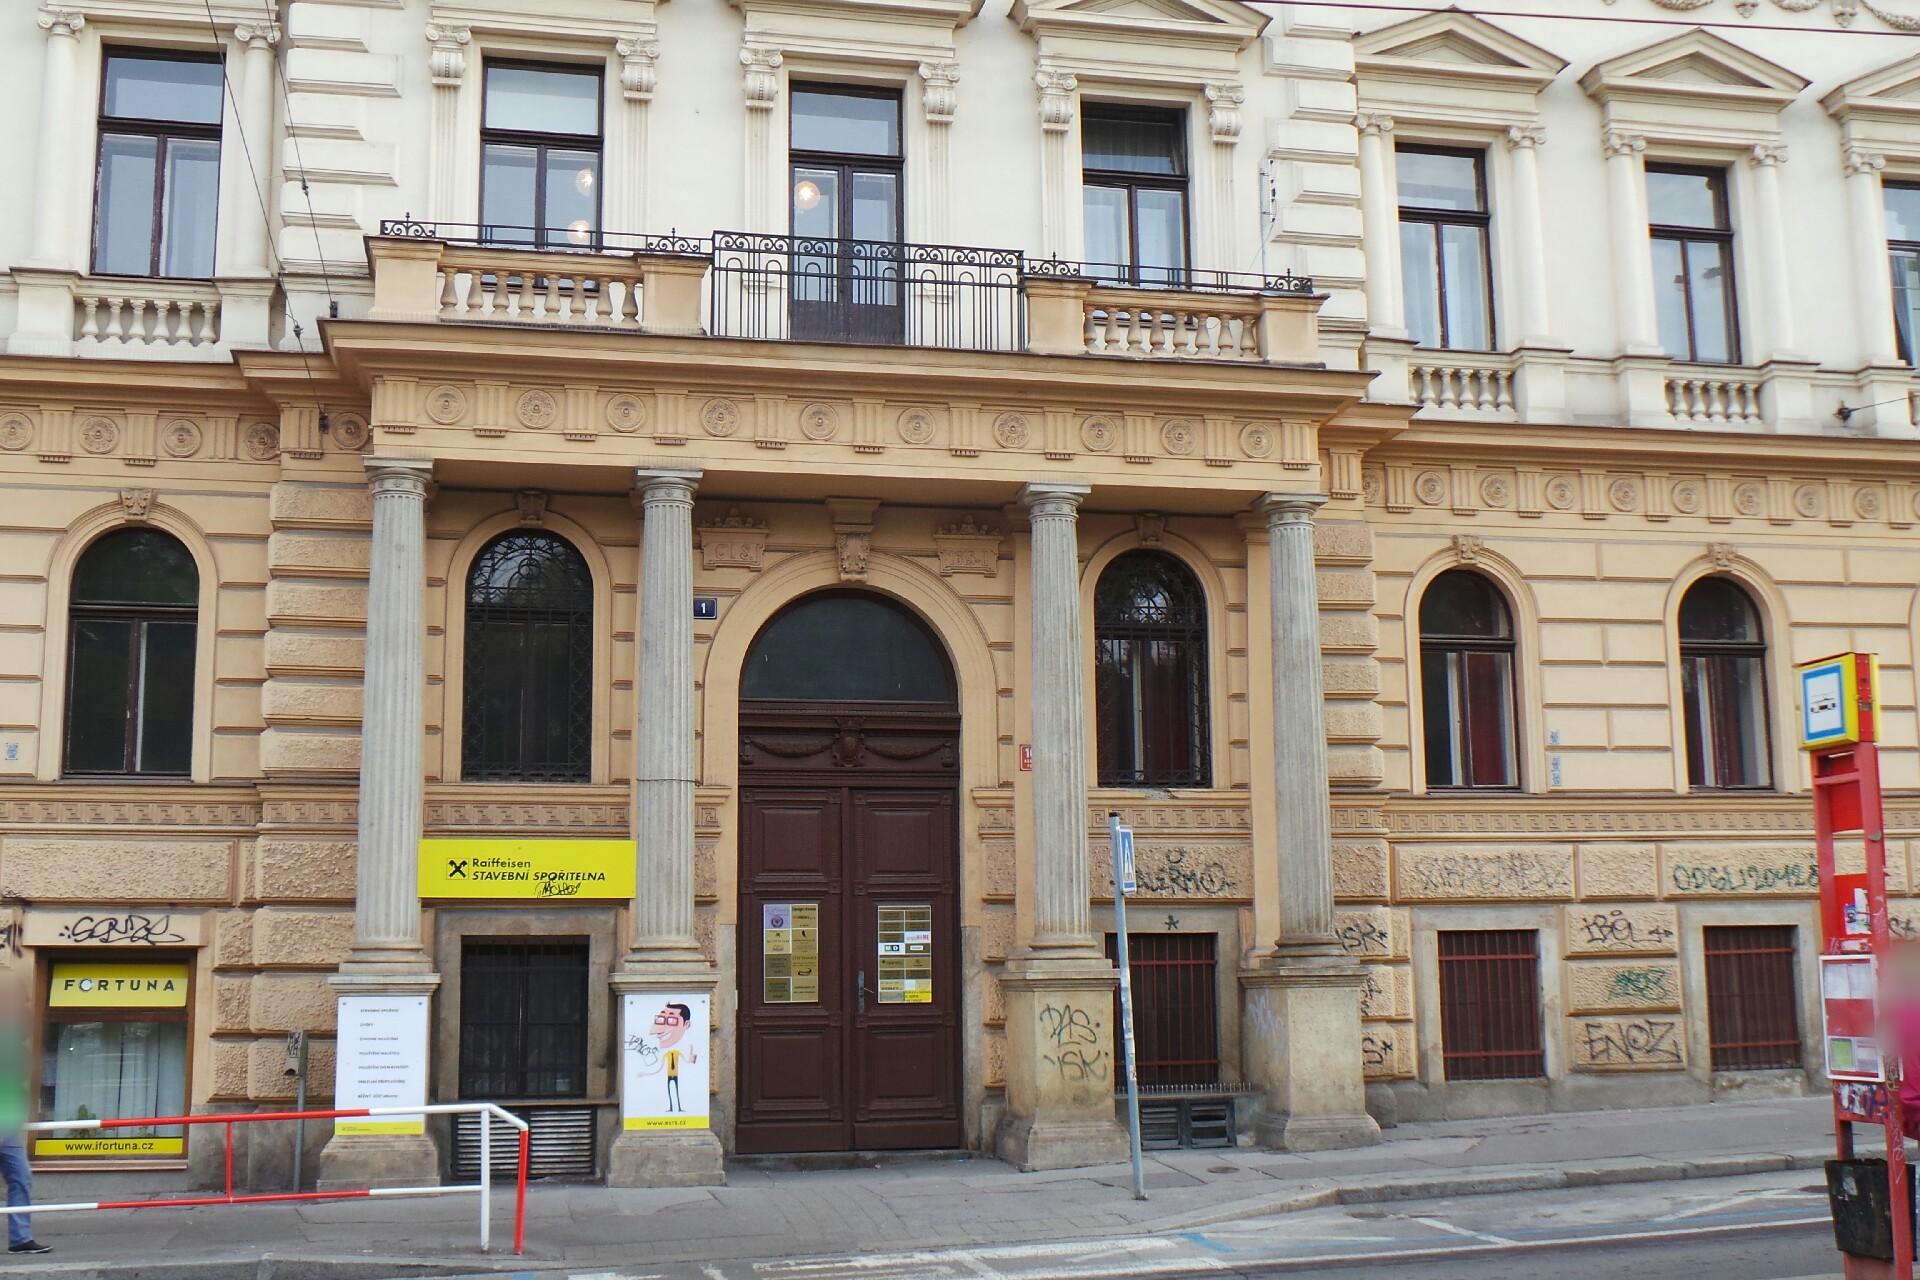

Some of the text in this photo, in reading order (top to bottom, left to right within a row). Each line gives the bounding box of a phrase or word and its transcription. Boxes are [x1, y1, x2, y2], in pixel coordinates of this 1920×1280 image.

[472, 858, 531, 868] Raiffeisen
[472, 869, 606, 881] STAVEBNÍ SPOŘITELNA
[64, 978, 175, 992] FORTUNA
[65, 1141, 154, 1151] www.ifortuna.cz
